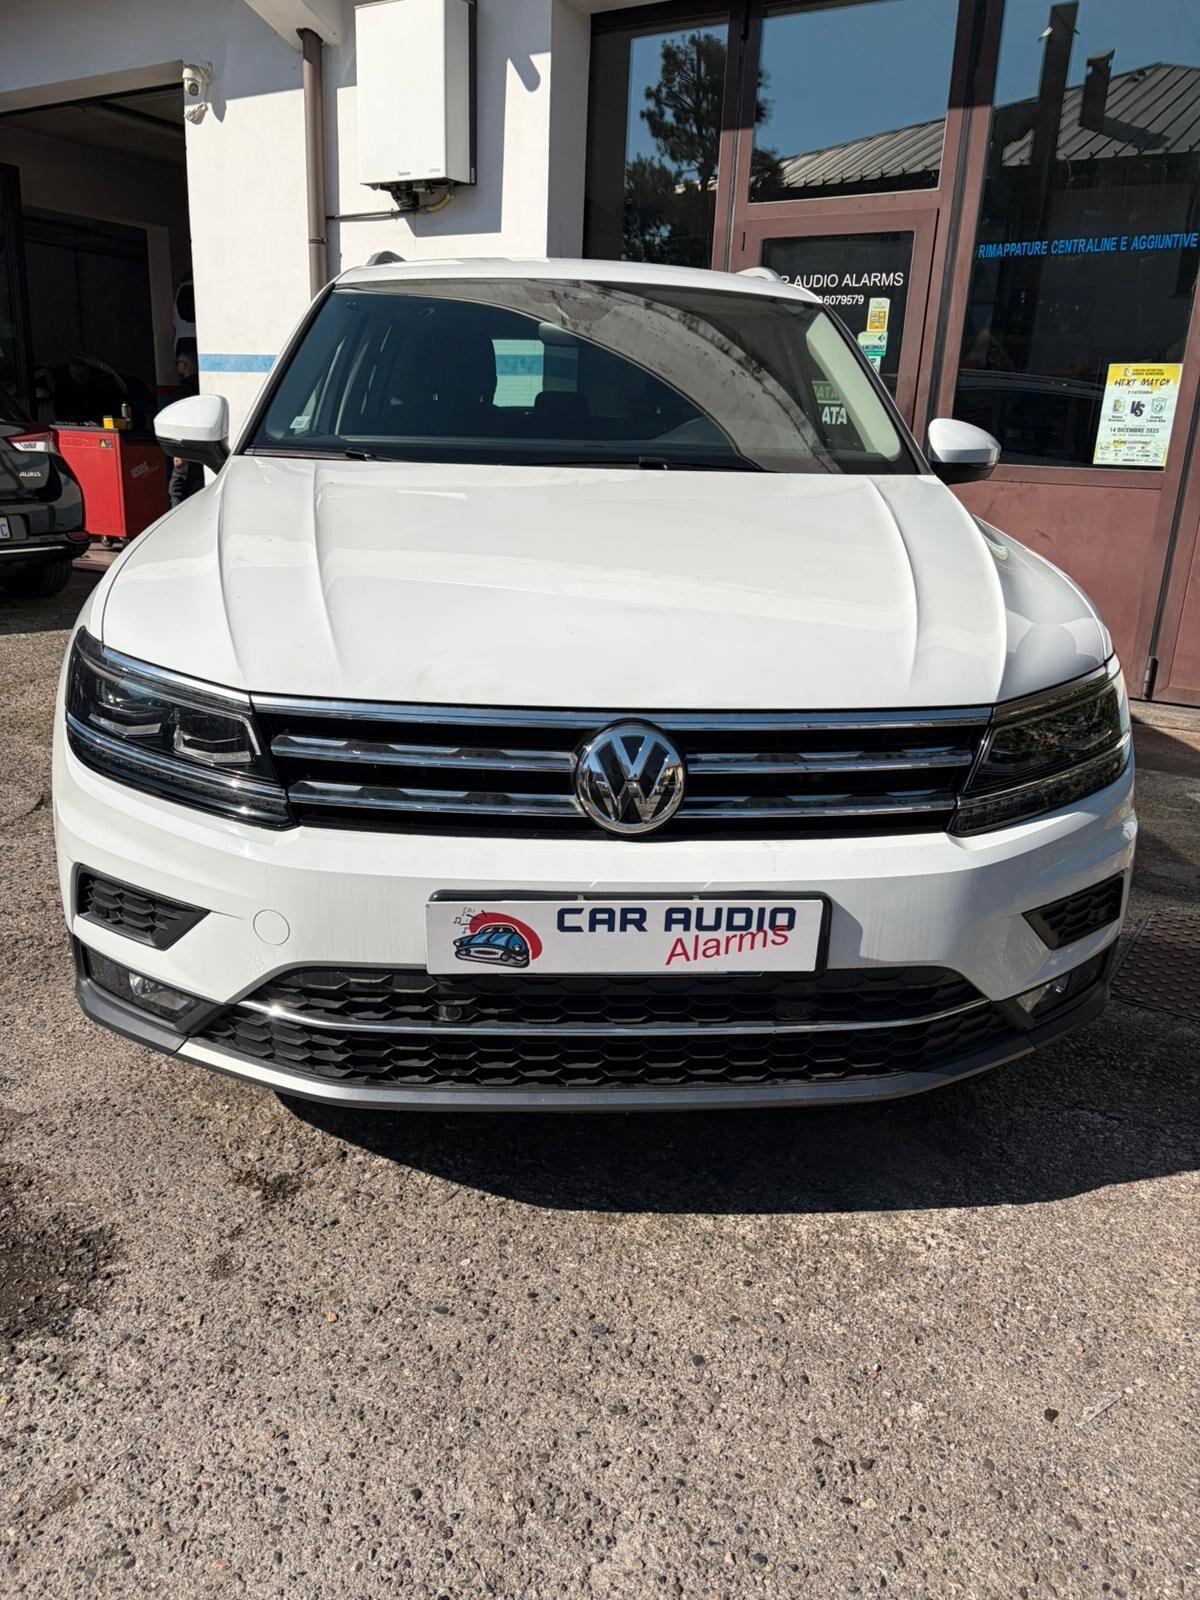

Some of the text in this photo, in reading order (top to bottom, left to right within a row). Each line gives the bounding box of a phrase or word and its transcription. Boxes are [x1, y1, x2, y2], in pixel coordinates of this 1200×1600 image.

[978, 232, 1199, 258] RIMAPPATURE CENTRALINE E AGGIUNTIVE
[793, 274, 838, 288] AUDIO
[841, 272, 904, 287] ALARMS
[1114, 377, 1171, 387] NEXT MATCH
[821, 406, 847, 425] ATA
[1130, 400, 1146, 417] VS
[556, 907, 796, 932] CAR AUDIO
[665, 924, 790, 965] Alarms
